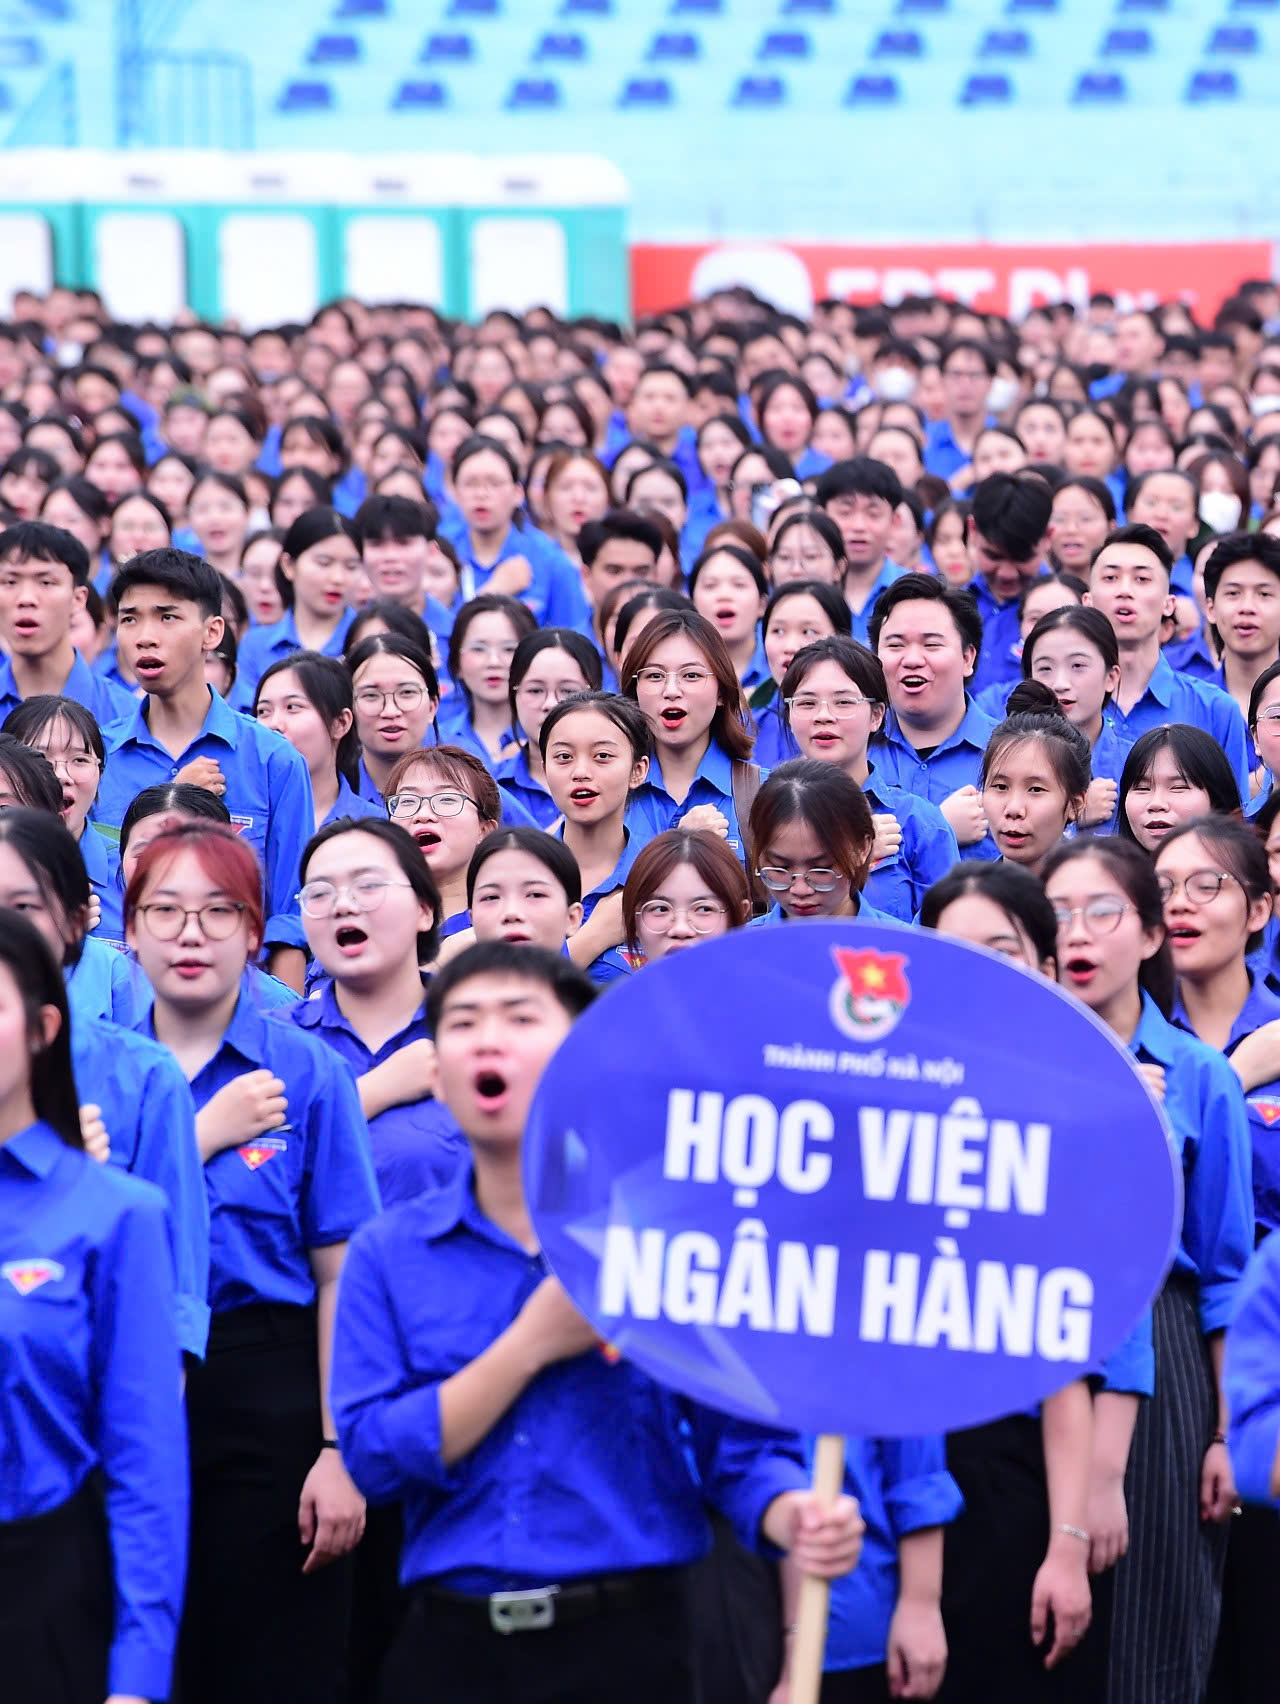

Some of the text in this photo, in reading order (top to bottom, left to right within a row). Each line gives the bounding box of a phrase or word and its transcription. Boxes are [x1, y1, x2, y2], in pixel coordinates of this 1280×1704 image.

[763, 1042, 966, 1088] THÀNH PHỐ HÀ NỘI
[664, 1088, 1051, 1229] HỌC VIỆN
[601, 1218, 1094, 1363] NGÂN HÀNG
